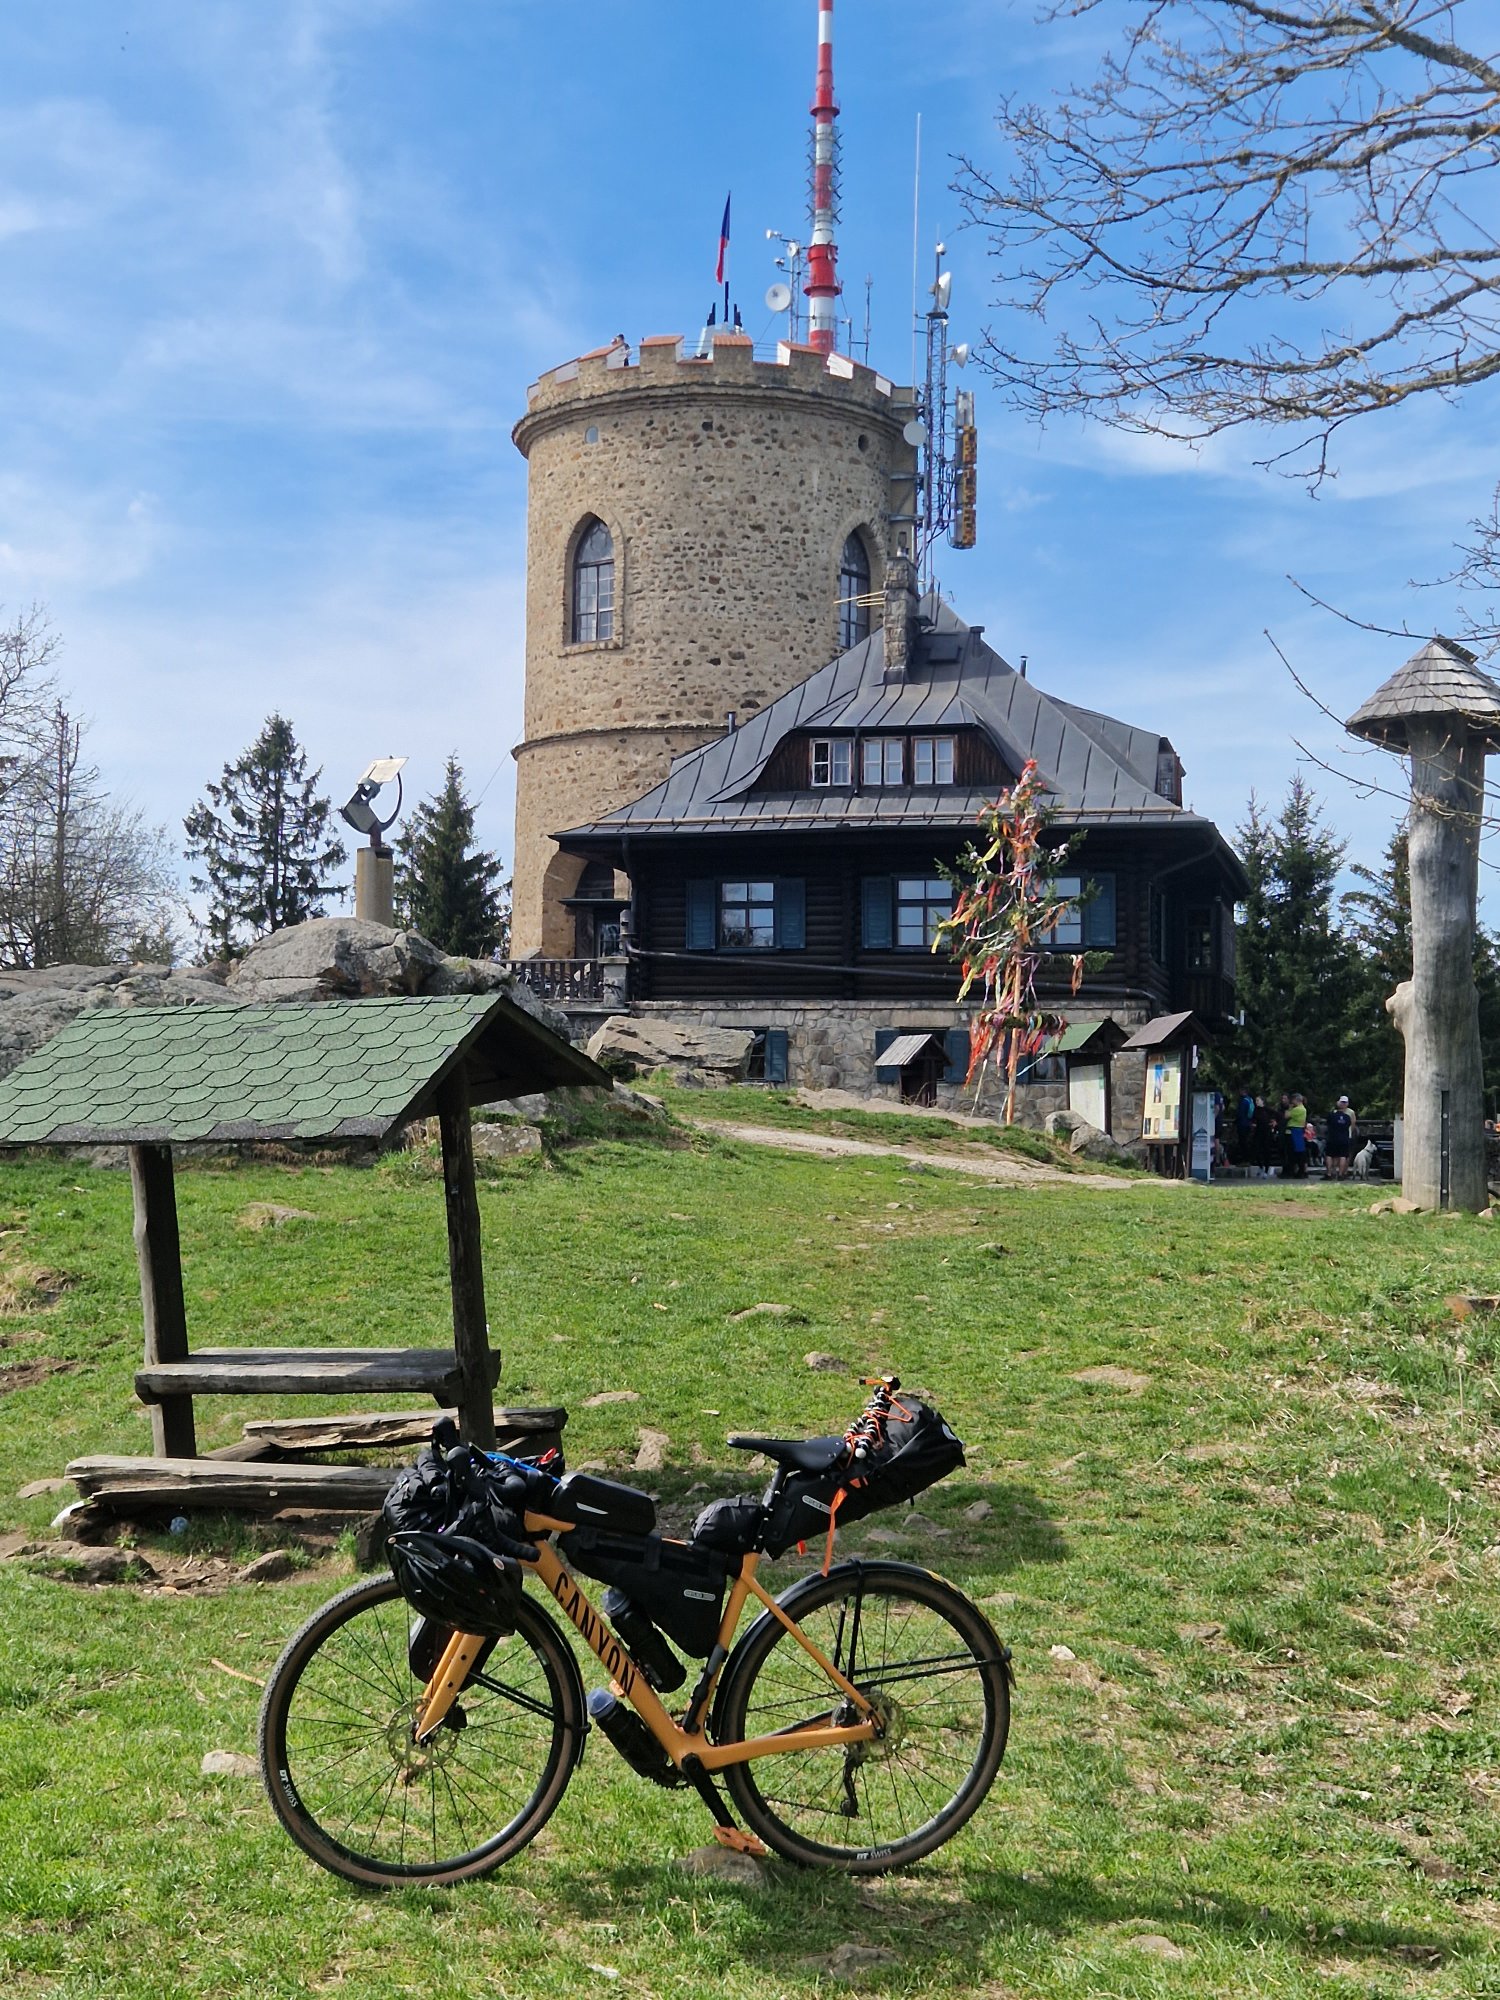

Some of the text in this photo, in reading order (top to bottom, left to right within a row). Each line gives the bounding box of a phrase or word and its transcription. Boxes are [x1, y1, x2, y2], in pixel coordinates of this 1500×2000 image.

[554, 1571, 636, 1697] CANYON
[279, 1769, 299, 1808] DT SWISS
[856, 1848, 892, 1861] DT SWISS
